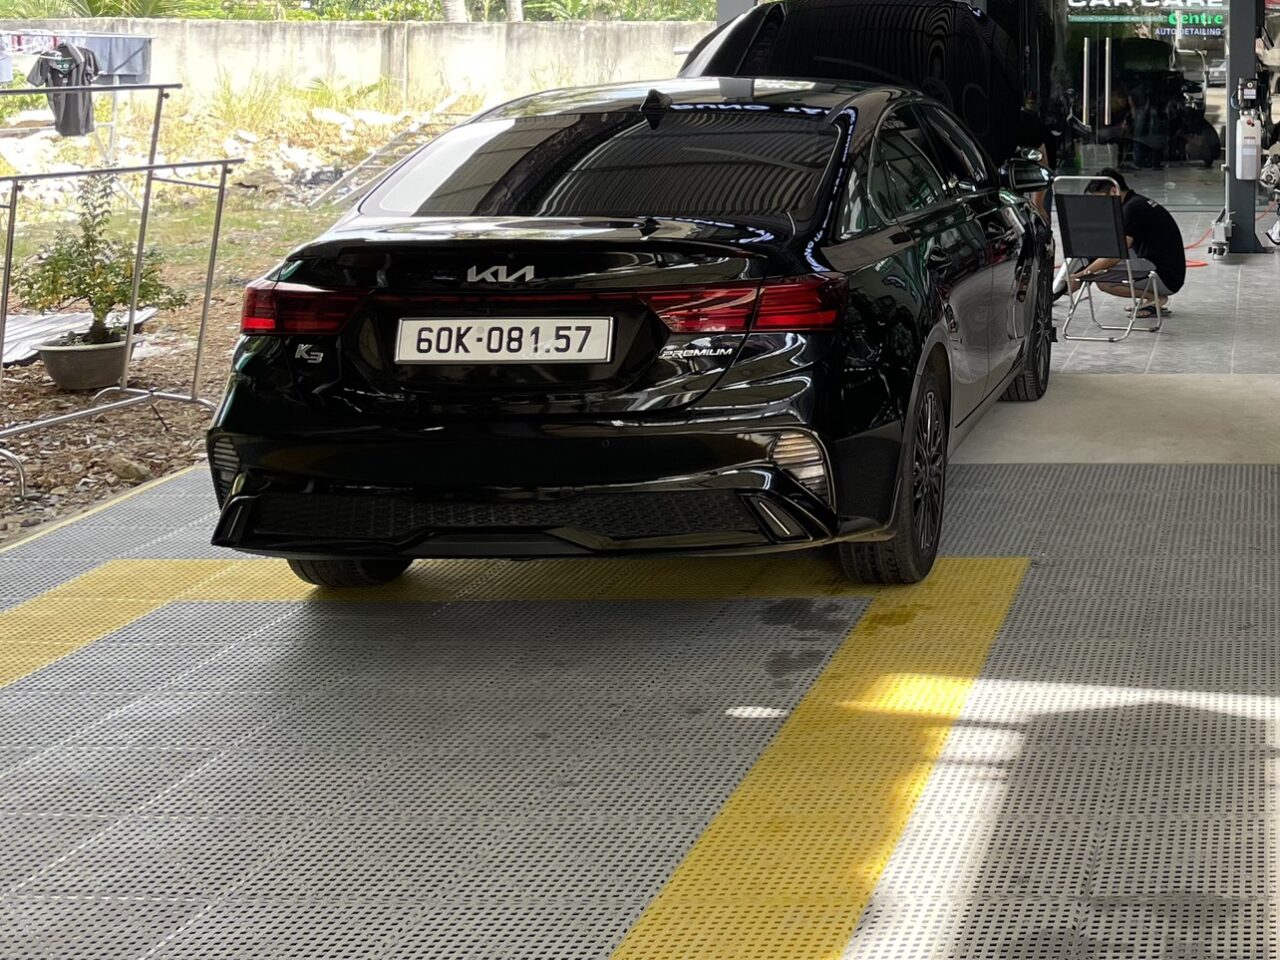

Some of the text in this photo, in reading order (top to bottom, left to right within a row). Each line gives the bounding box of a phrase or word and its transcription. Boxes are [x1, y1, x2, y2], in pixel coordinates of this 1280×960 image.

[1168, 12, 1224, 25] Centre
[1155, 28, 1221, 36] AUTO DETAILING
[467, 265, 535, 283] KIA
[416, 325, 592, 354] 60K-081.57
[294, 343, 324, 364] K3
[660, 348, 733, 359] PREMIUM
